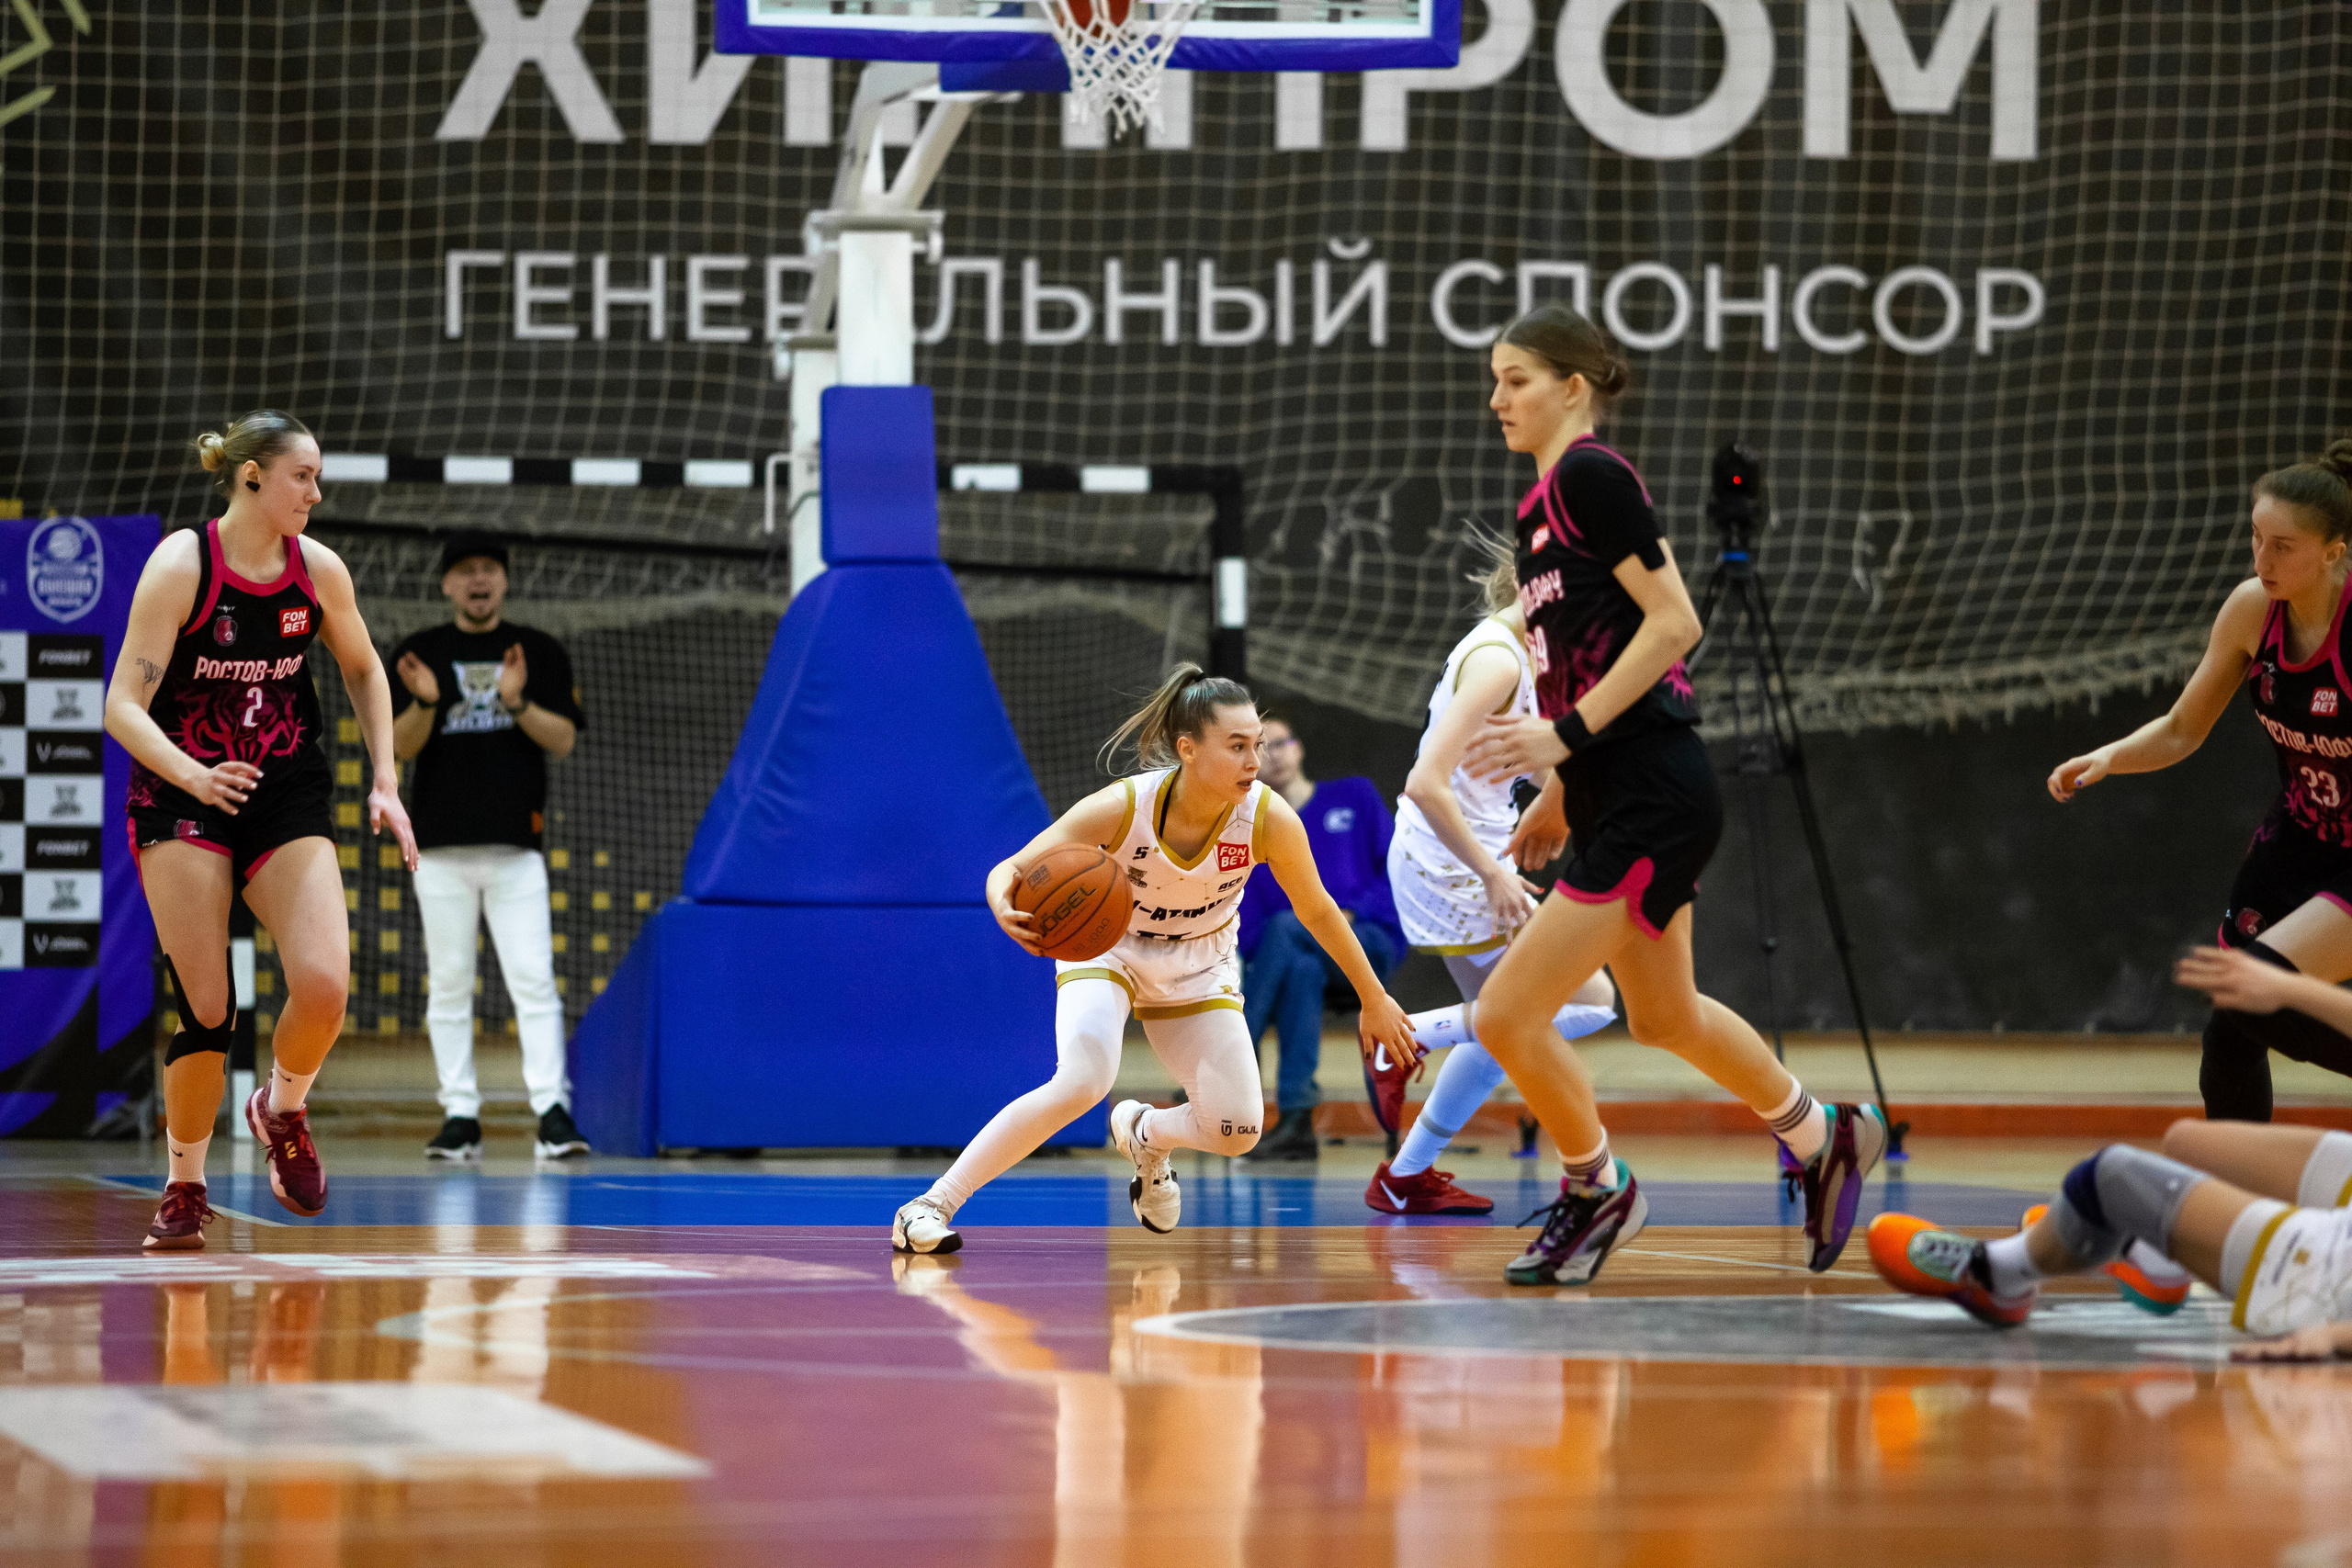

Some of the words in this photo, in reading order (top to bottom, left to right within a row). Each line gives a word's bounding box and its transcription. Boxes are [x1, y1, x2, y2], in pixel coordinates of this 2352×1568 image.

[434, 0, 2040, 160] ХИРОМ
[445, 237, 1388, 347] ГЕНЕРЛЬНЫЙ
[1430, 258, 2045, 355] СПОНСОР
[282, 609, 307, 623] FON
[283, 620, 307, 634] BET
[193, 653, 304, 683] РОСТОВ-ЮФ
[2313, 690, 2337, 701] FON
[243, 686, 263, 728] 2
[2312, 701, 2337, 713] BET
[2255, 709, 2352, 759] ОСТОВ-ЮФ
[1219, 845, 1248, 857] FON
[1220, 855, 1247, 868] BET
[1238, 1125, 1259, 1134] GUL
